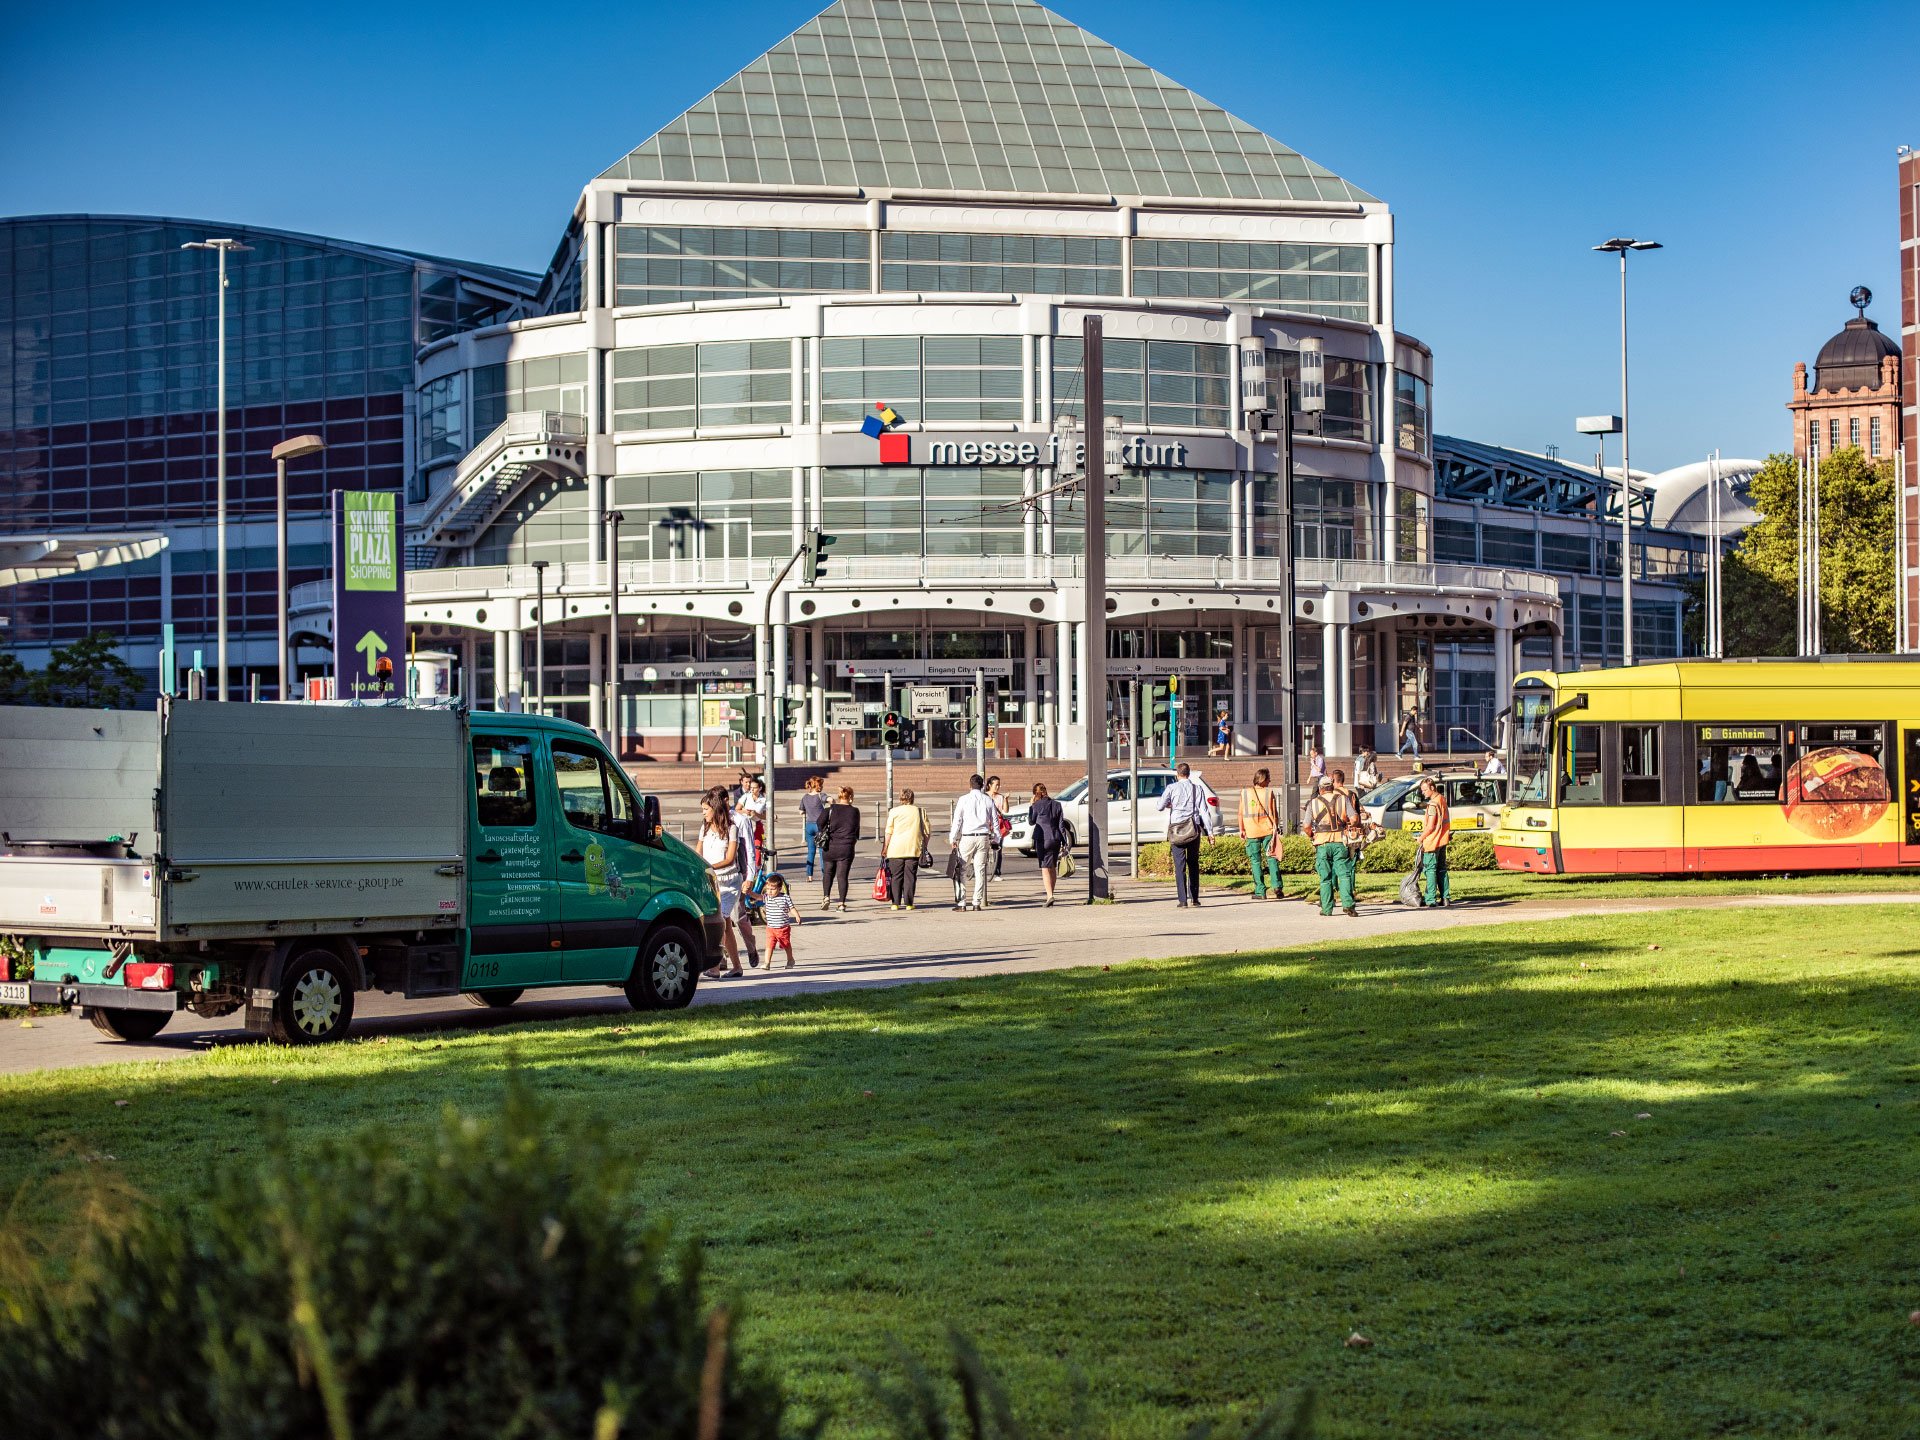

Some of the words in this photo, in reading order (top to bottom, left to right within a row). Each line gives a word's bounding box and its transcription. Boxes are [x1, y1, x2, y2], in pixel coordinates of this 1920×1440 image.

[929, 440, 1038, 463] messe
[350, 511, 390, 533] SKYLINE
[350, 533, 391, 565] PLAZA
[350, 565, 391, 580] SHOPPING
[928, 666, 955, 674] Eingang
[957, 666, 971, 674] City
[1155, 665, 1179, 673] Eingang
[1180, 665, 1191, 673] City
[367, 682, 394, 692] MEER
[1702, 728, 1712, 740] 16
[1722, 728, 1765, 739] Ginnheim
[1410, 821, 1423, 831] 23
[470, 961, 499, 978] 0118
[3, 986, 25, 999] 3118
